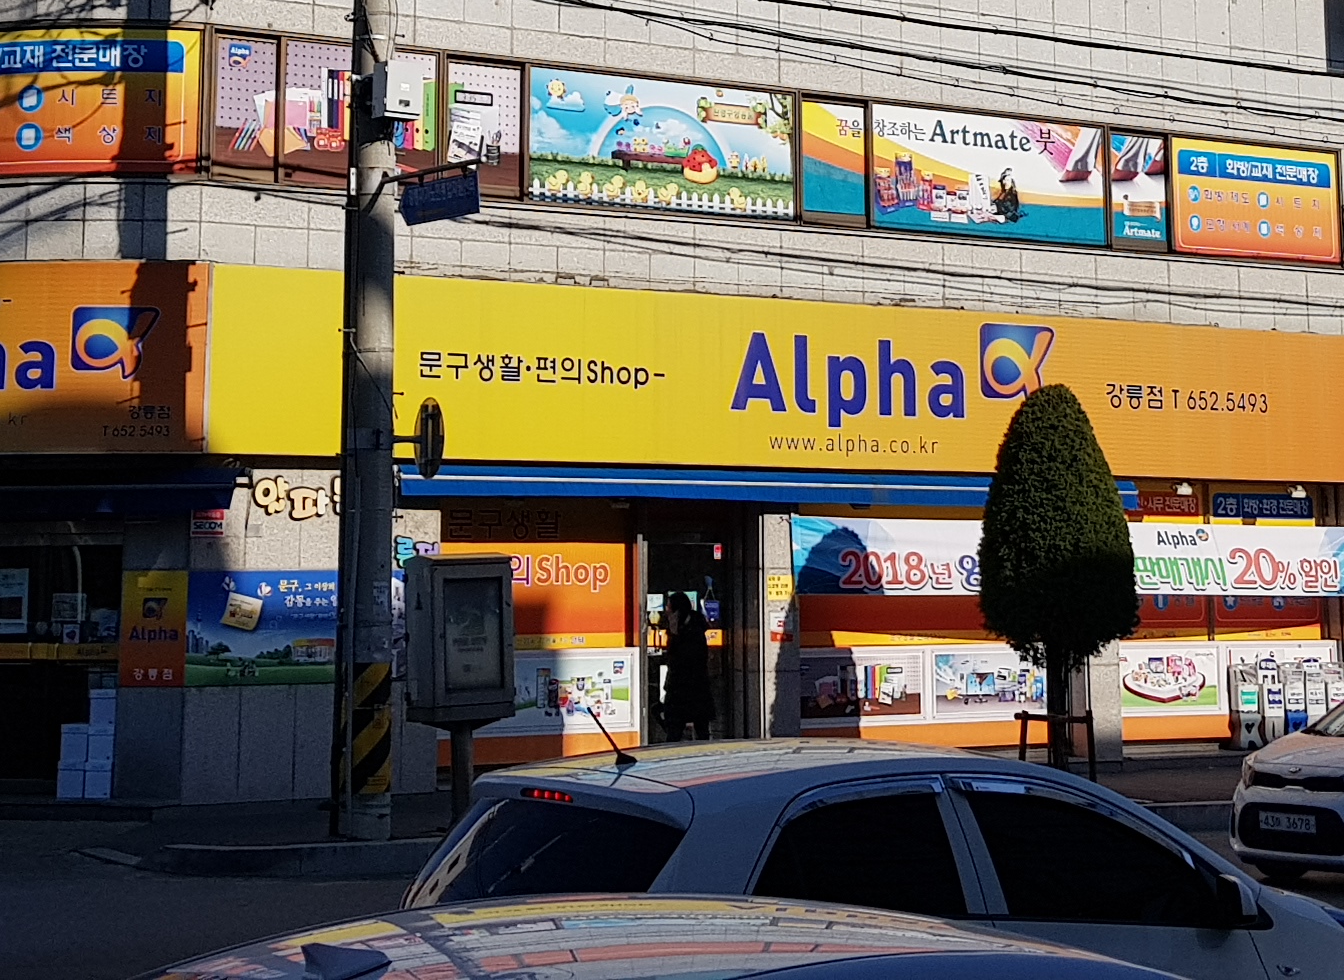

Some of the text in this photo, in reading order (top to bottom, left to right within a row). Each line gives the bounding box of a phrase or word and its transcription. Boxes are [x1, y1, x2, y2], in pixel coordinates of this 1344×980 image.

[51, 44, 148, 68] 전문매장
[836, 119, 1056, 156] 꿈을 창조하는 Artmate 붓
[1190, 156, 1209, 172] 2층
[1276, 164, 1319, 184] 전문매장
[730, 331, 966, 427] Alpha
[128, 404, 172, 420] 강릉점
[1105, 383, 1163, 410] 강릉점
[1186, 391, 1269, 415] 652.5493
[769, 433, 939, 453] www.alpha.co.kr
[253, 476, 330, 521] 알파
[1217, 497, 1237, 515] 2층
[448, 508, 562, 540] 문구생활
[1157, 530, 1197, 549] Alpha
[1228, 548, 1297, 590] 20%
[1299, 558, 1341, 591] 할인
[129, 625, 179, 642] Alpha
